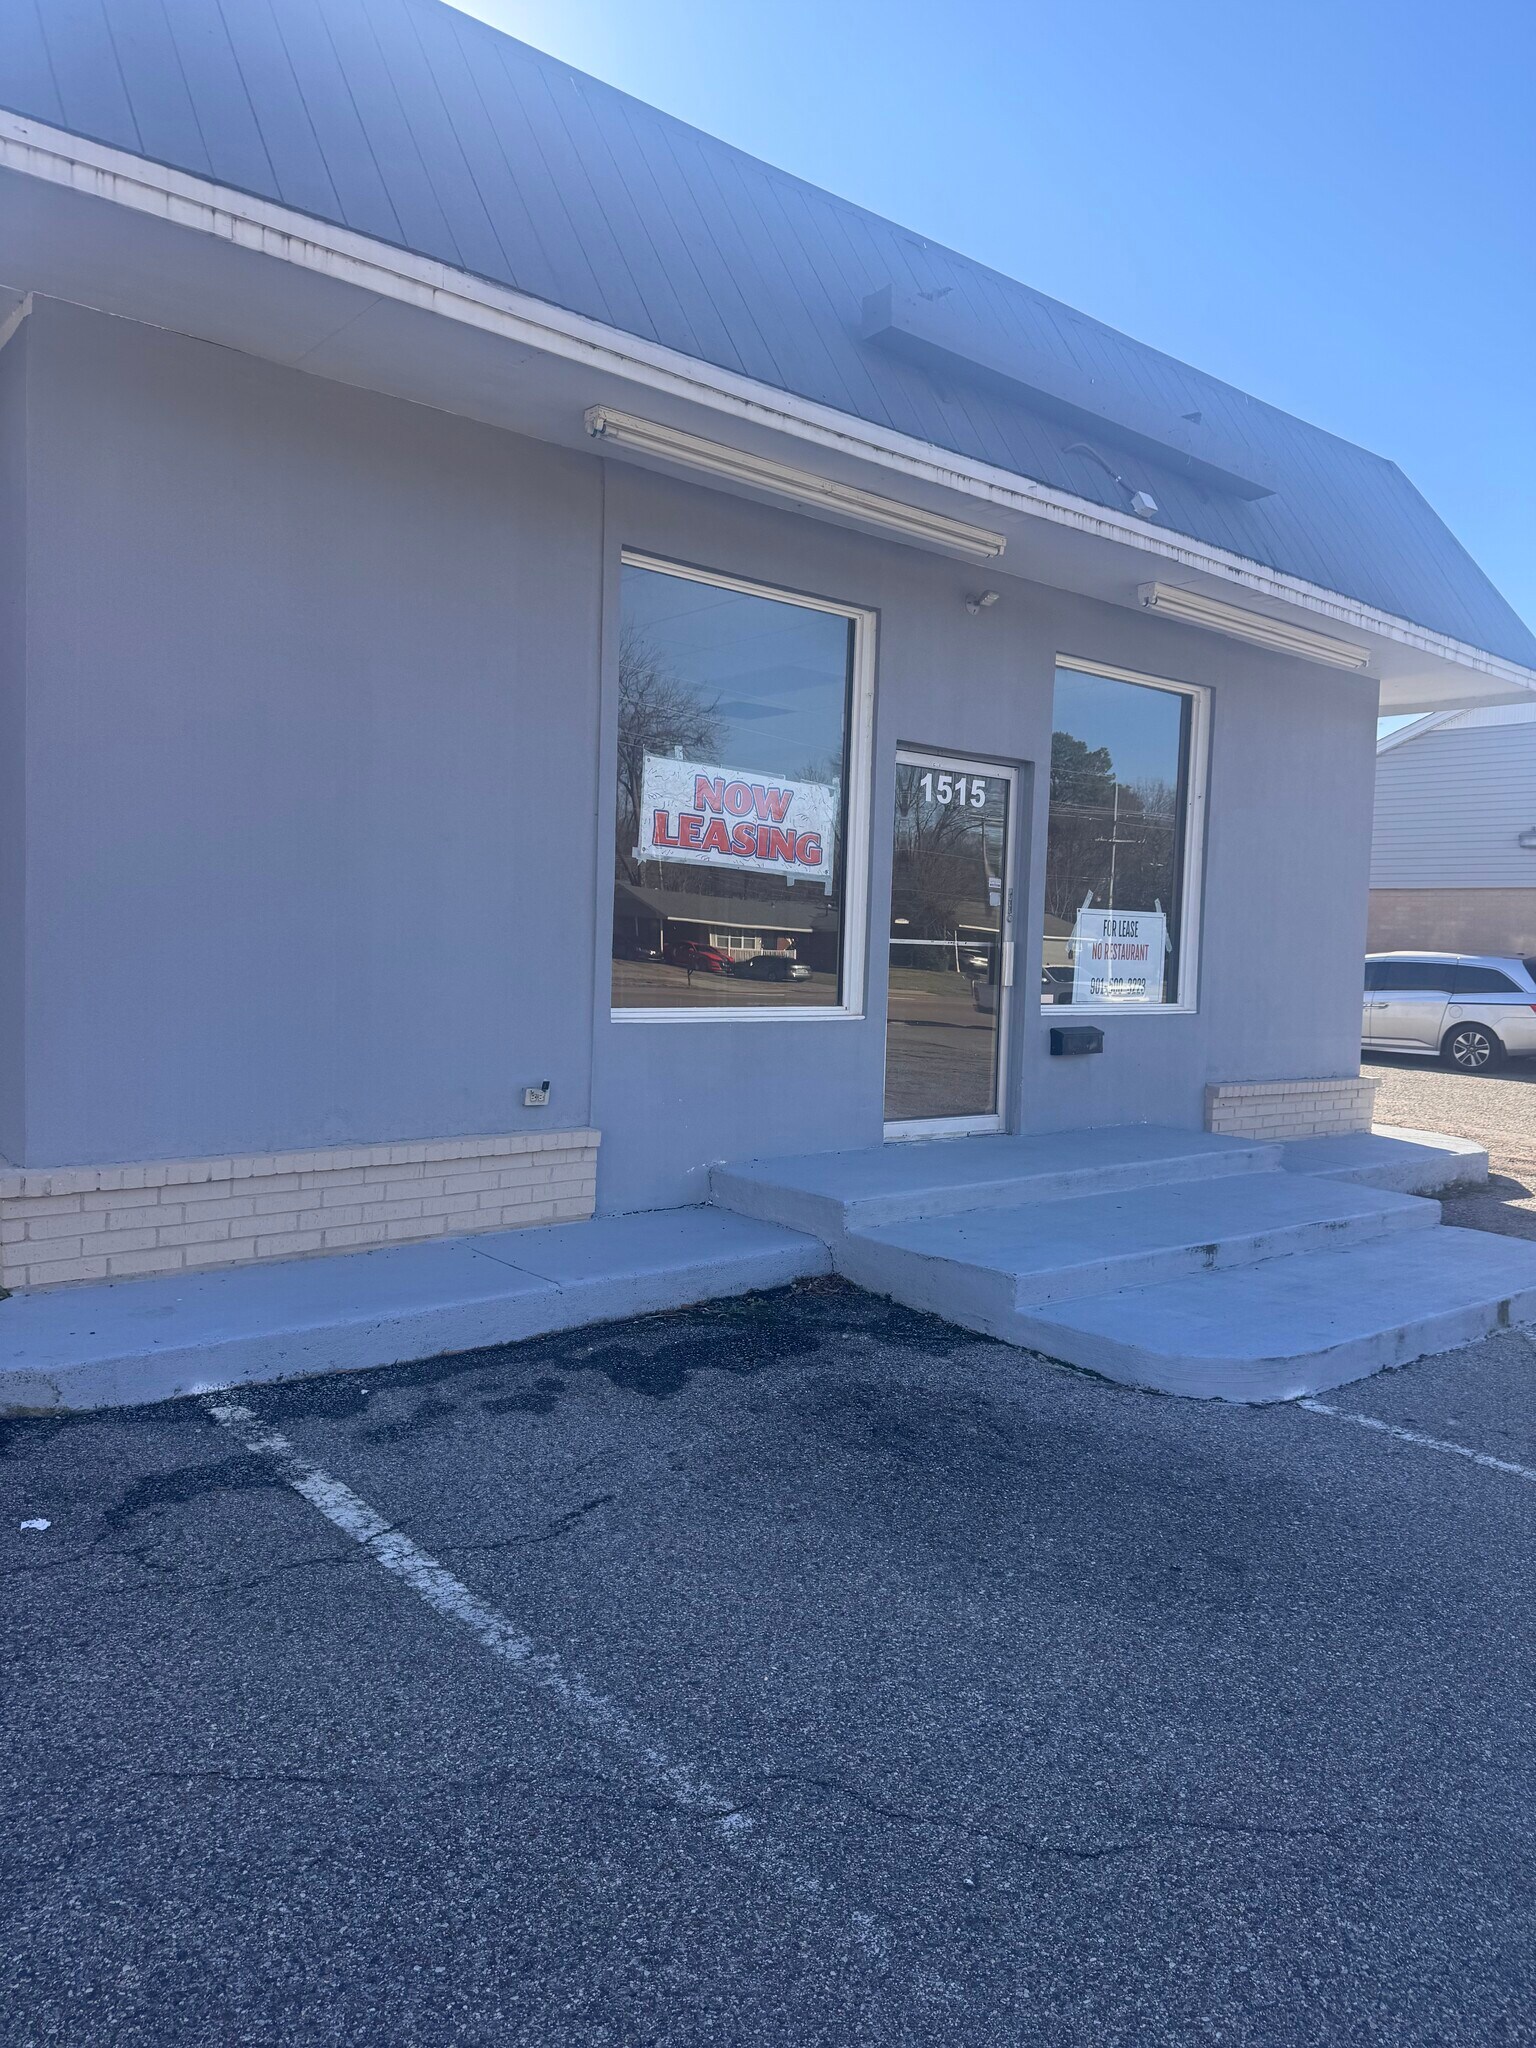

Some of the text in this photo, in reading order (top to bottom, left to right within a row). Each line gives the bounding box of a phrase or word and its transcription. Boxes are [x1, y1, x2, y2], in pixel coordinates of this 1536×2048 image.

[693, 774, 794, 823] NOW
[920, 773, 986, 808] 1515
[653, 809, 823, 866] LEASING
[1103, 919, 1139, 938] FOR LEASE
[1092, 942, 1149, 961] NO RESTAURANT
